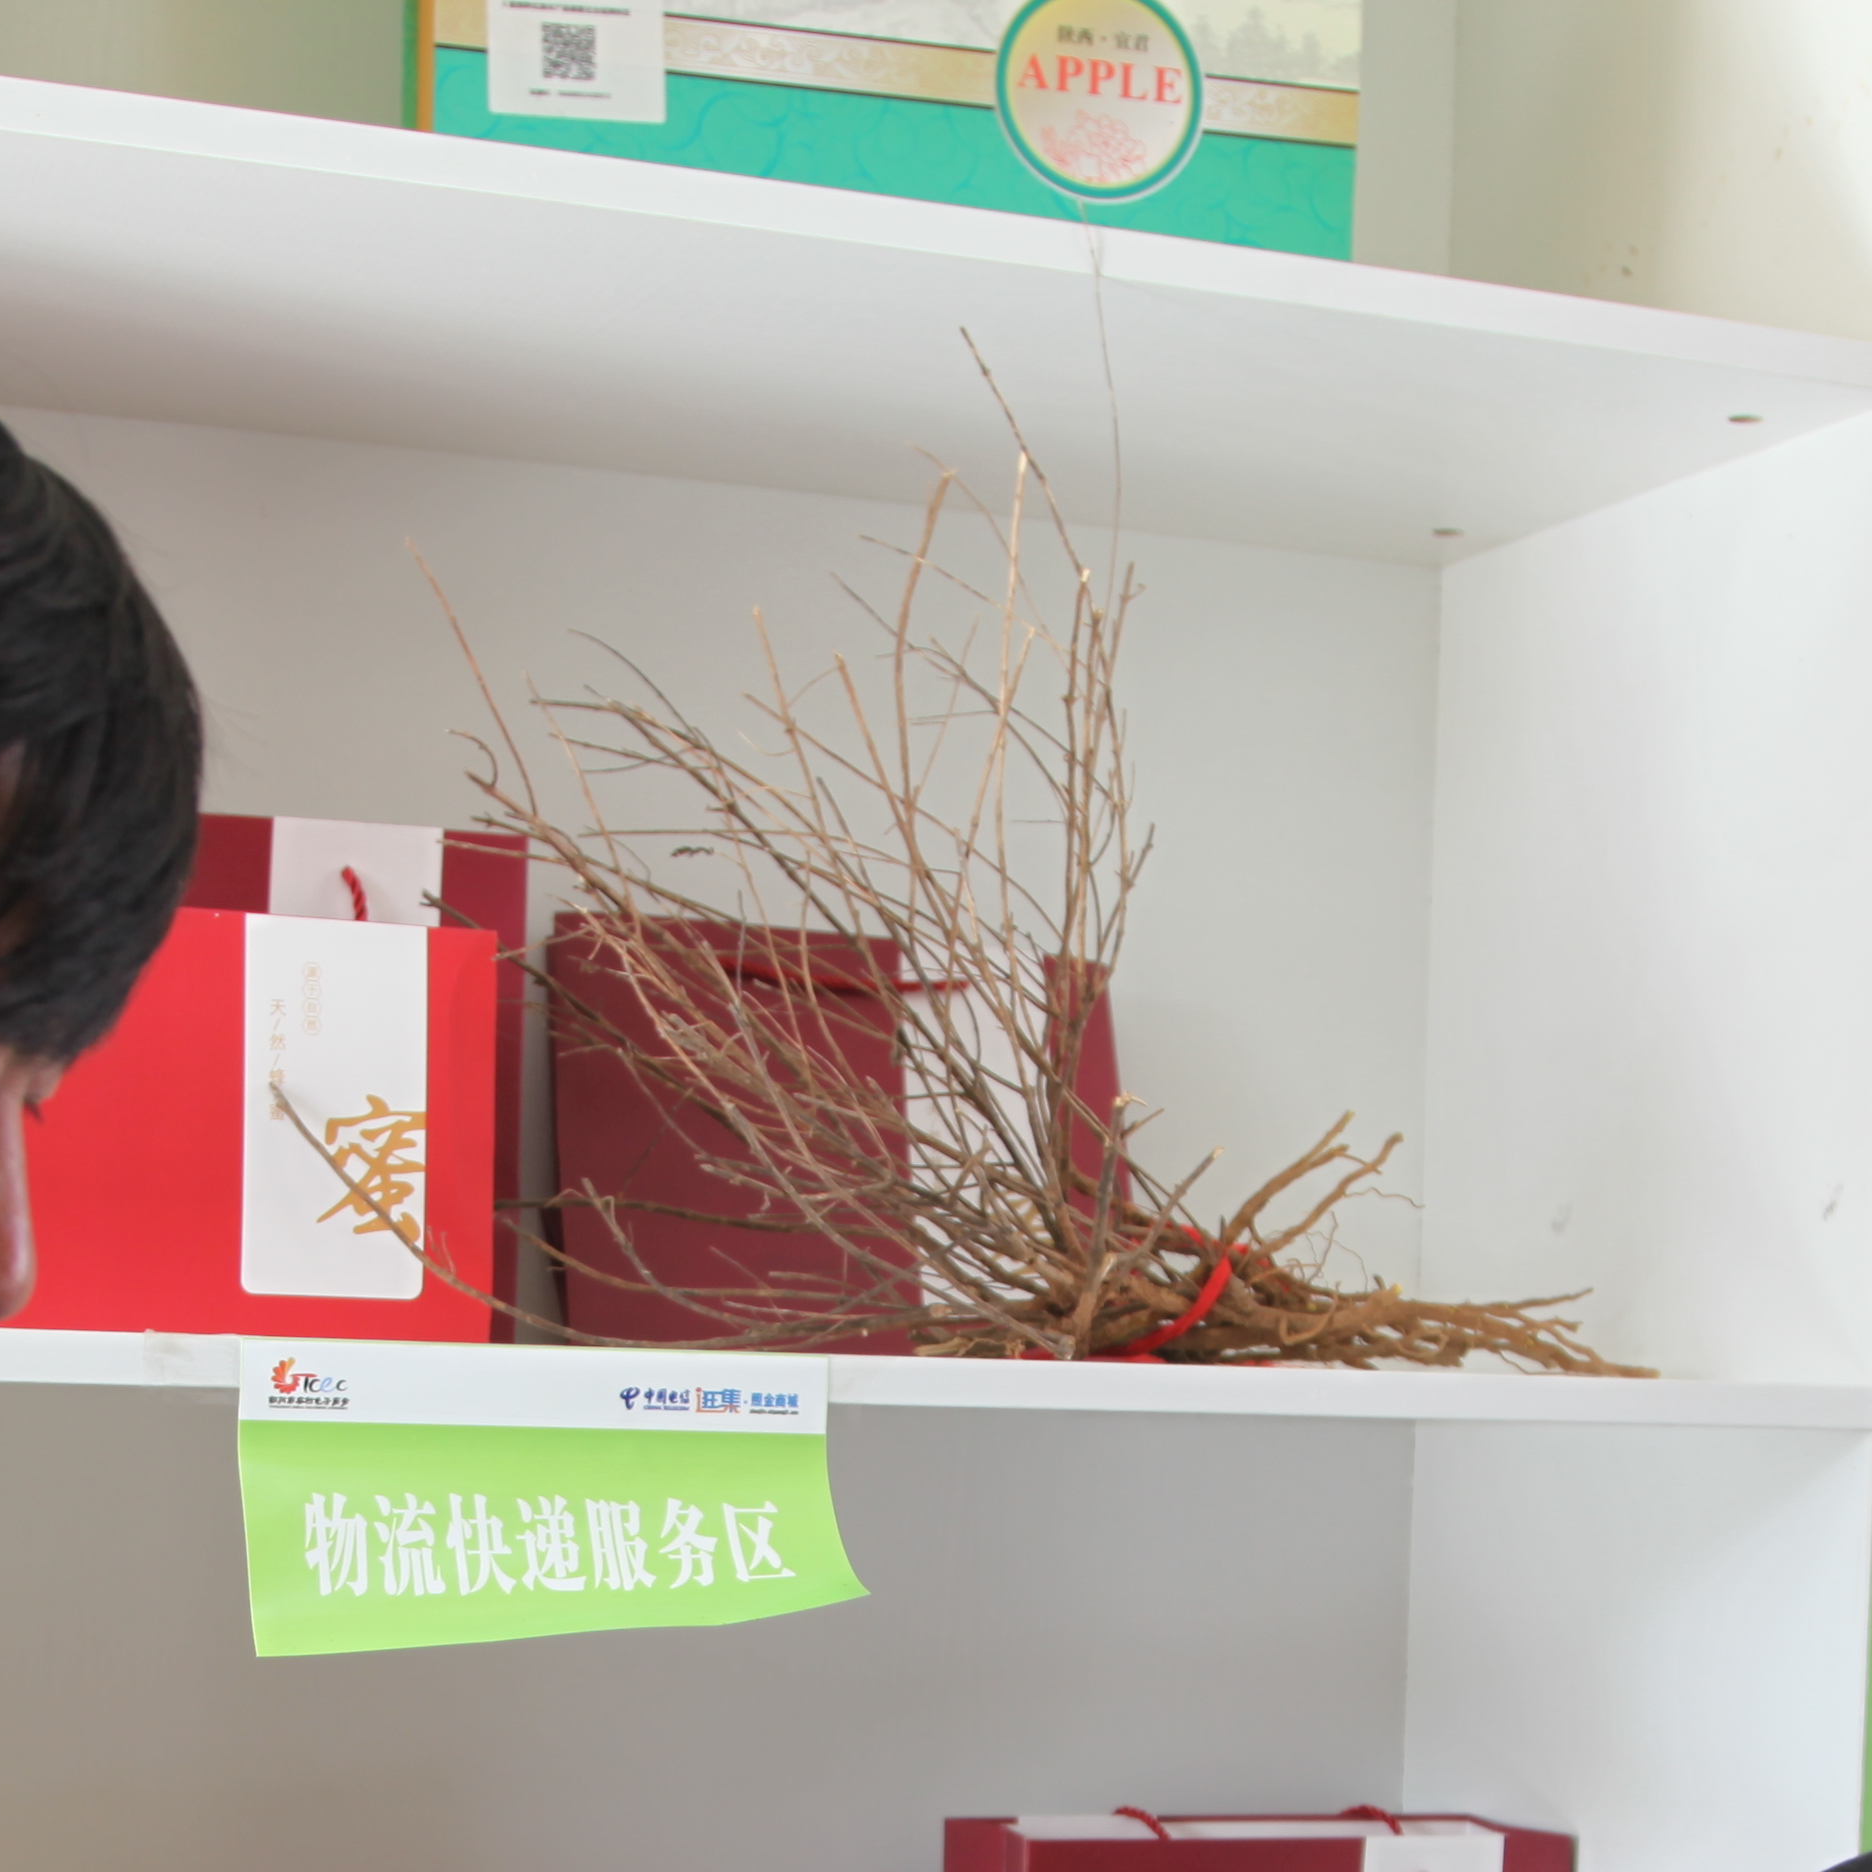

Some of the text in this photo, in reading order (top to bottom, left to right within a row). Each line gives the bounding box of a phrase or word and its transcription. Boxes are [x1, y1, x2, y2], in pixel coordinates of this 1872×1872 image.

[1017, 52, 1183, 104] APPLE
[317, 1095, 426, 1243] 蜜
[644, 1387, 690, 1404] 中国电信
[304, 1492, 796, 1597] 物流快递服务区
